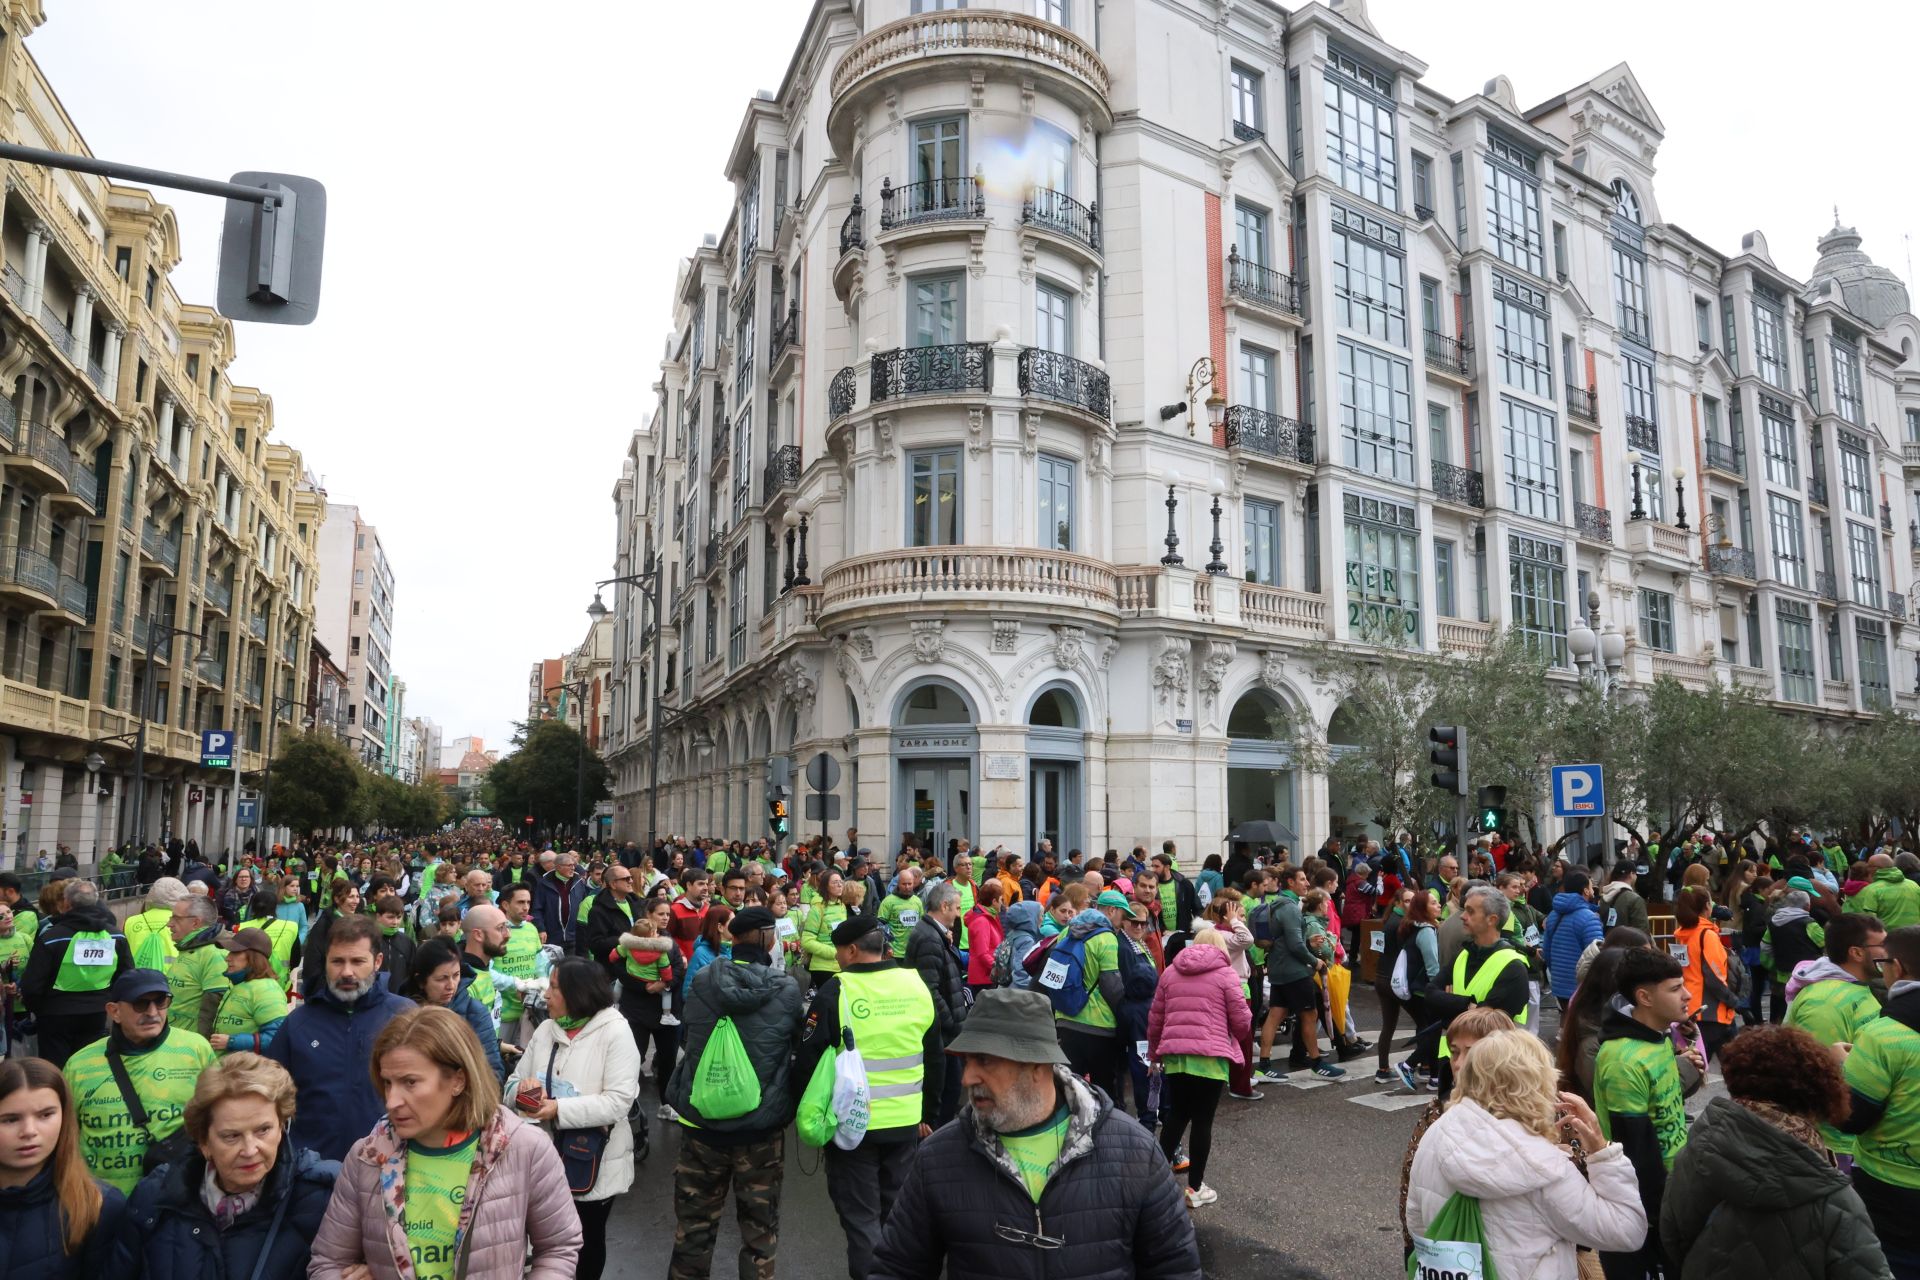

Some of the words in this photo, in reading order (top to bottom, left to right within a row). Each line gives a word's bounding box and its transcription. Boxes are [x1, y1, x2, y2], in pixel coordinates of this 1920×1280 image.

[1348, 603, 1415, 633] 2000
[208, 733, 226, 753] P
[900, 739, 928, 747] ZARA
[933, 739, 967, 747] HOME
[1561, 771, 1593, 811] P
[239, 802, 254, 817] T
[83, 949, 105, 959] 8773
[502, 956, 515, 965] En
[502, 964, 531, 975] contra
[96, 1095, 123, 1105] Vallad
[109, 1103, 182, 1126] mrch
[102, 1151, 143, 1170] cán
[405, 1220, 434, 1231] dolid
[410, 1243, 453, 1265] mar
